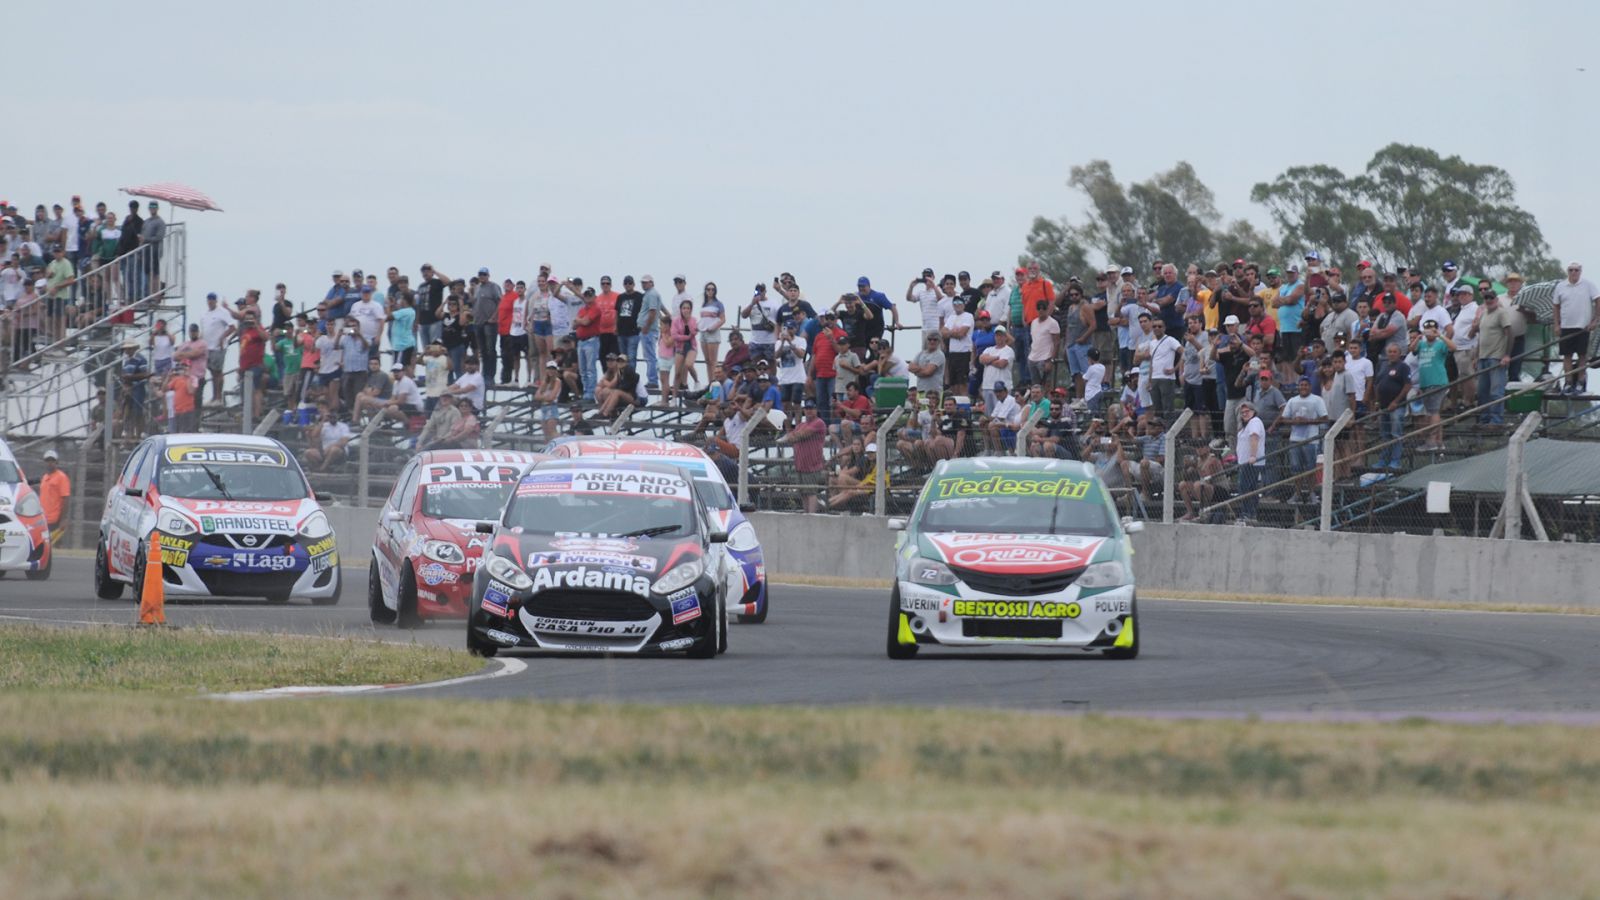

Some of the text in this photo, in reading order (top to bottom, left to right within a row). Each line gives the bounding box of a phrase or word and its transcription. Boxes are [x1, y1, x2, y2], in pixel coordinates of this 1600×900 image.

[574, 472, 688, 489] ARMANDO
[586, 481, 678, 496] DEL RIO
[938, 475, 1091, 499] Tedeschi
[248, 553, 296, 571] Lago
[531, 566, 651, 598] Ardama
[954, 600, 1081, 618] BERTOSSI AGRO
[535, 623, 578, 632] CASA
[587, 626, 615, 634] PIO
